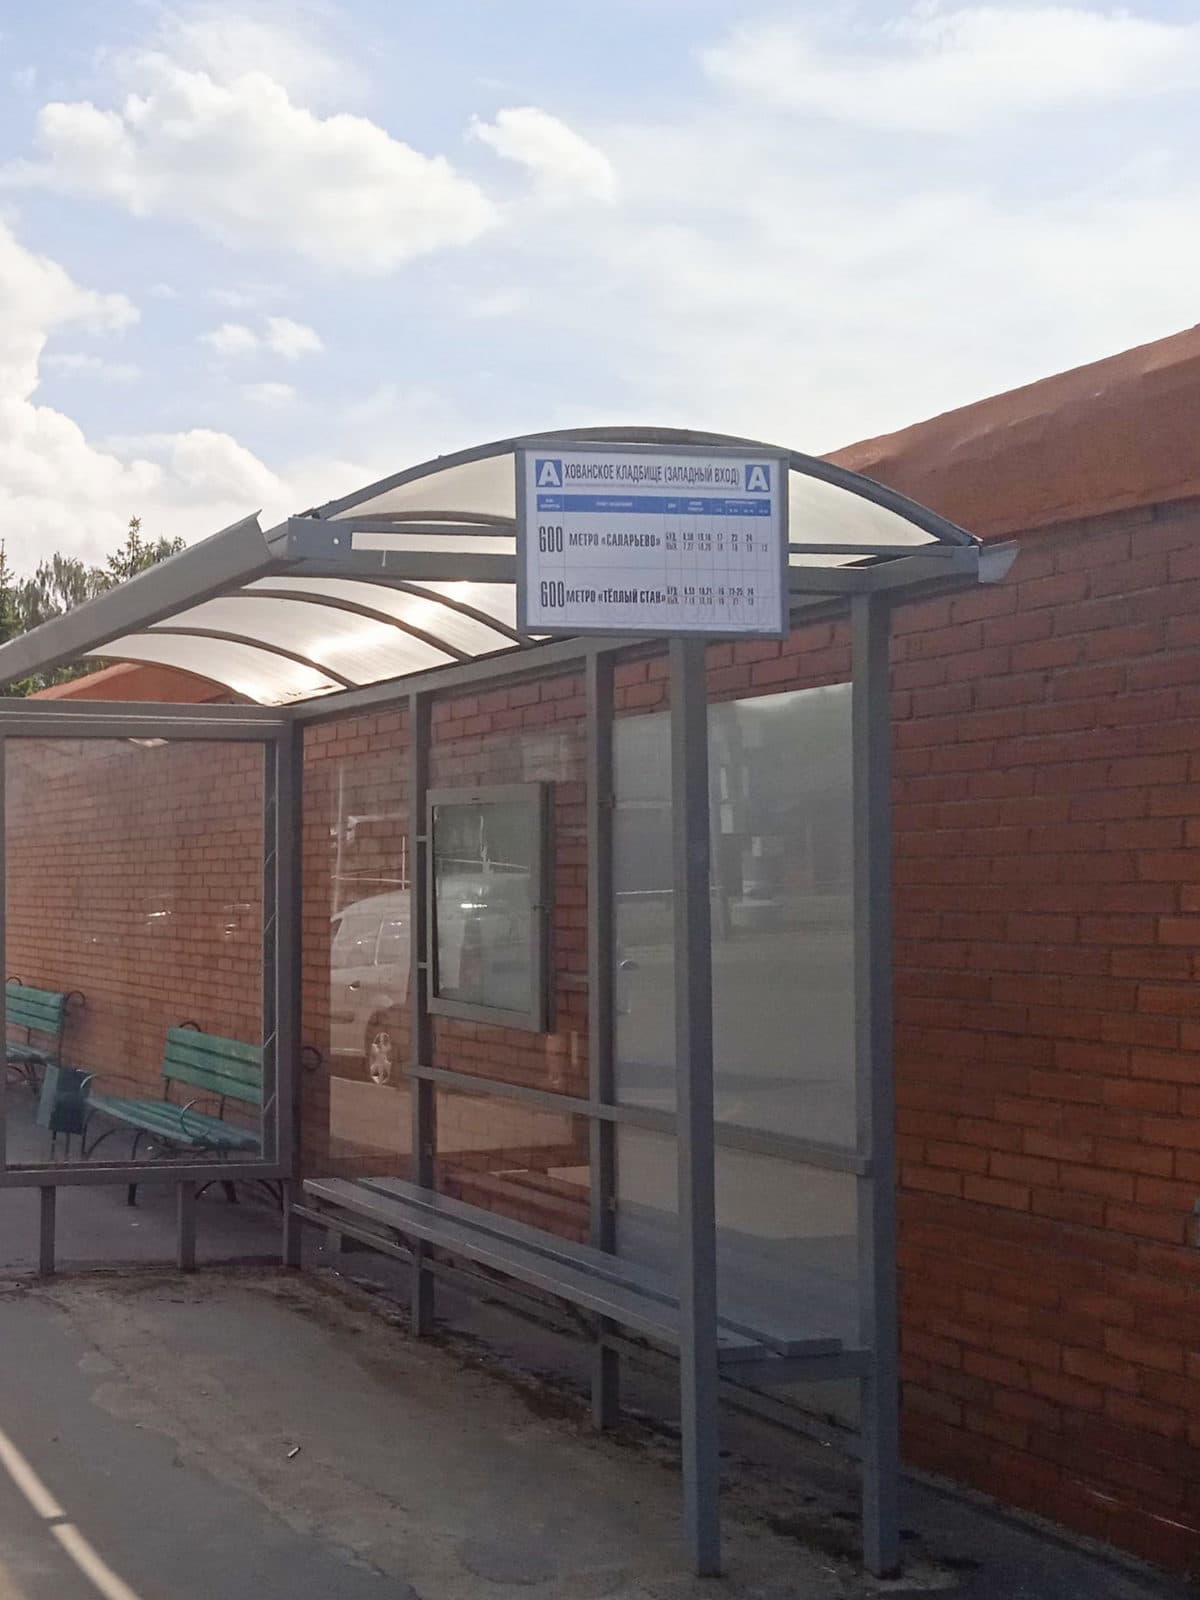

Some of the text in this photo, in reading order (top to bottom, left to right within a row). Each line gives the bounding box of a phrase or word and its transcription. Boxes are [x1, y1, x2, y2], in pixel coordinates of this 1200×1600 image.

[565, 464, 740, 486] ХОВАНСКОЕ КЛАДБИЩЕ (ЗАПАДНЫЙ ВХОД)
[539, 526, 661, 552] 600 МЕТРО «САЛАРЬЕВО»
[541, 581, 666, 608] 600 МЕТРО «ТЁПЛЫЙ СТАН»
